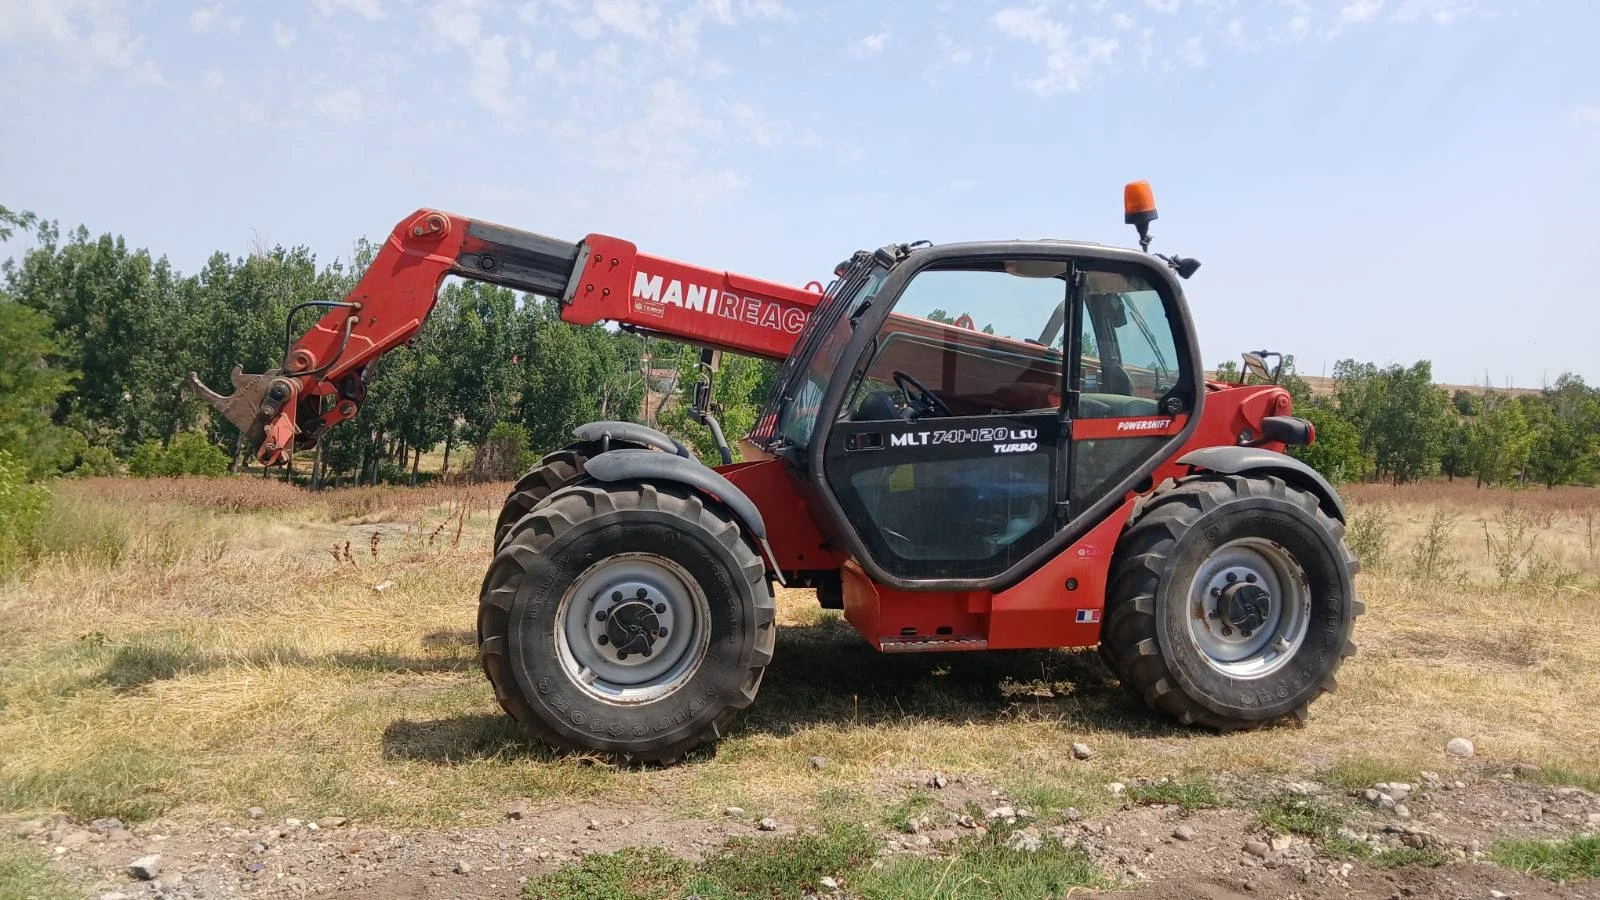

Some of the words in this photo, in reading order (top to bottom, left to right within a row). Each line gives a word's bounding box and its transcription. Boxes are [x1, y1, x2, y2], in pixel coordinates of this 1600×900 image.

[1117, 419, 1171, 430] POWERSHIFT
[890, 431, 931, 447] MLT
[932, 427, 1008, 444] 741-120
[1010, 429, 1037, 439] LSU
[993, 442, 1037, 453] TURBO
